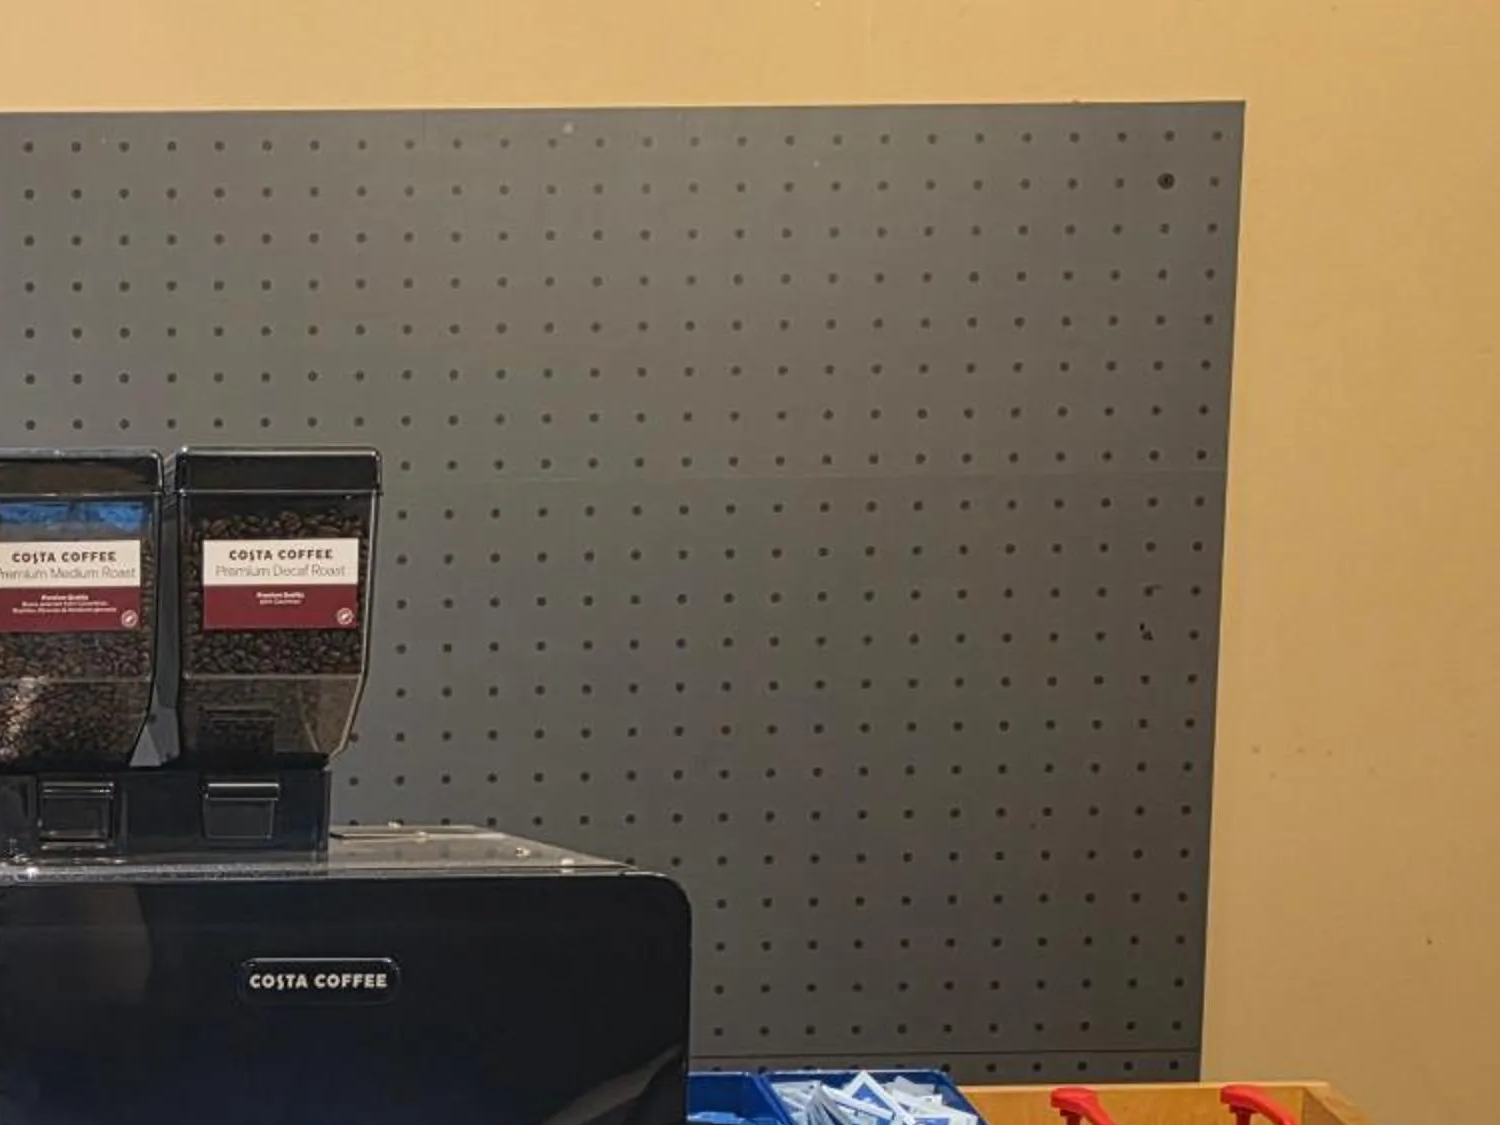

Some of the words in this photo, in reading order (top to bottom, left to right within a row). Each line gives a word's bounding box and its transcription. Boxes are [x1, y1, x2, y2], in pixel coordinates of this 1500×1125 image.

[11, 552, 57, 564] COSTA
[61, 551, 117, 562] COFFEE
[229, 549, 273, 561] COSTA
[278, 549, 334, 559] COFFEE
[51, 567, 99, 579] Medium
[102, 565, 136, 578] Roast
[215, 565, 270, 577] Premium
[273, 564, 309, 576] Decaf
[311, 563, 346, 576] Roast
[250, 973, 308, 990] COSTA
[314, 973, 388, 988] COFFEE
